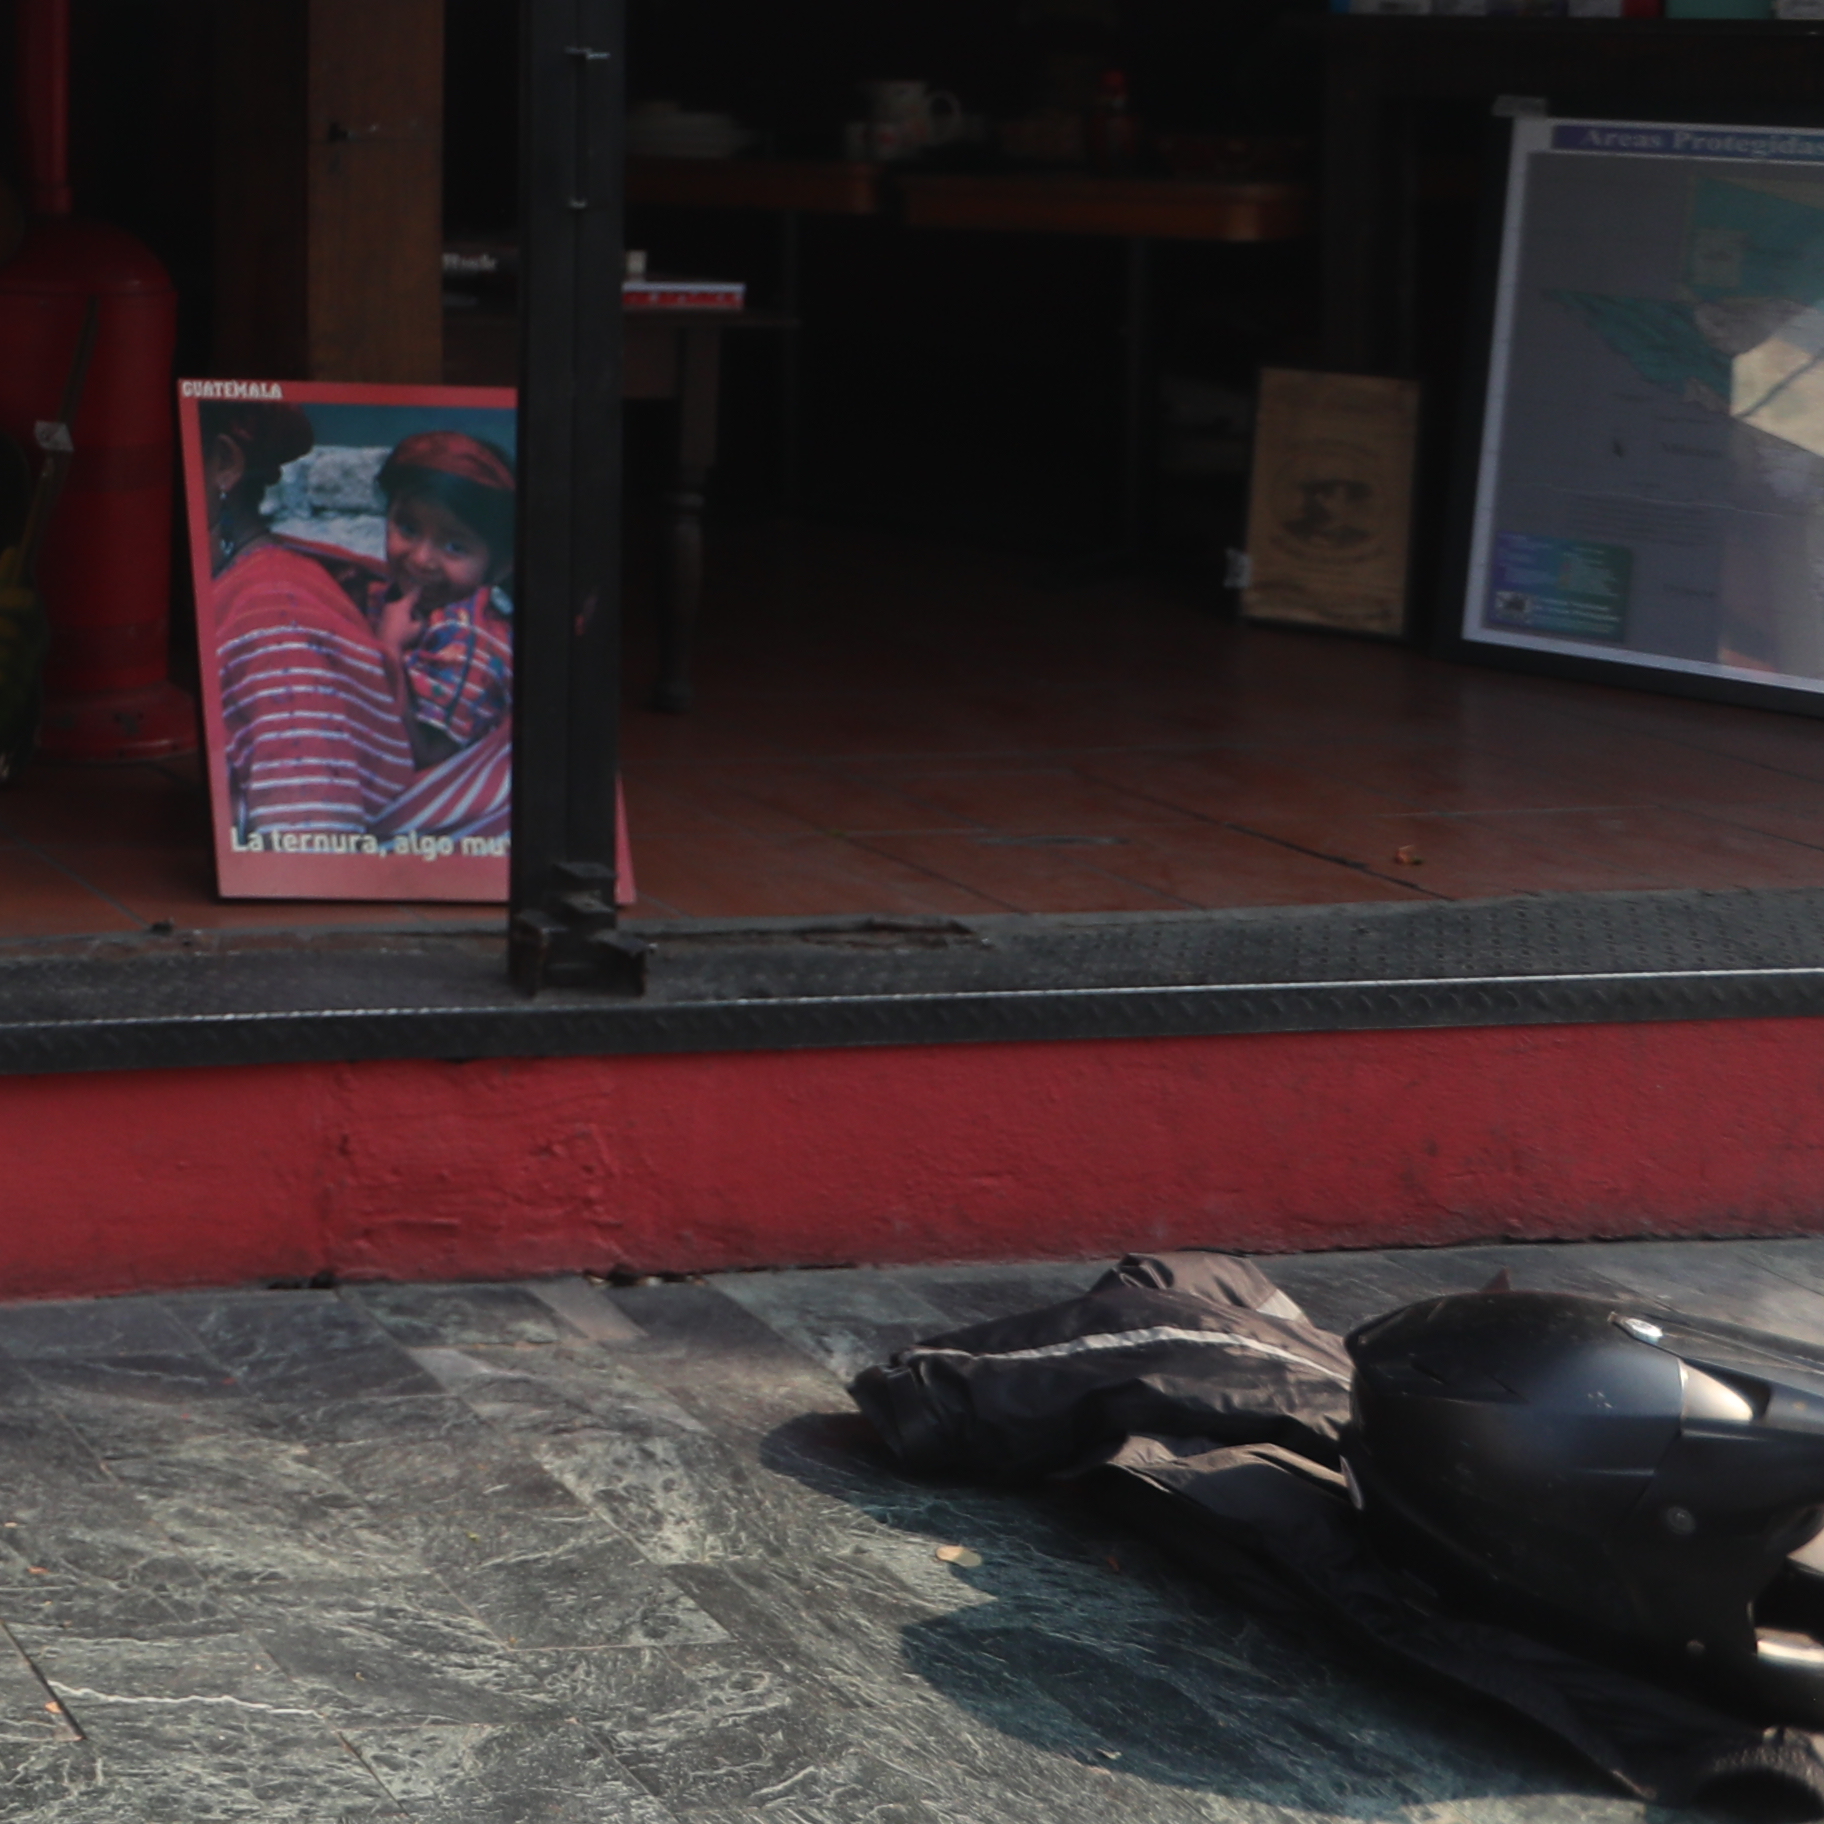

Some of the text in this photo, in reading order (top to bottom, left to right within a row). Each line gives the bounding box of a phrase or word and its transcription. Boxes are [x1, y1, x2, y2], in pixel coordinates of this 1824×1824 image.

[181, 379, 283, 400] GUATEMALA
[231, 827, 264, 852] La
[271, 829, 386, 857] ternura,
[392, 830, 454, 860] algo
